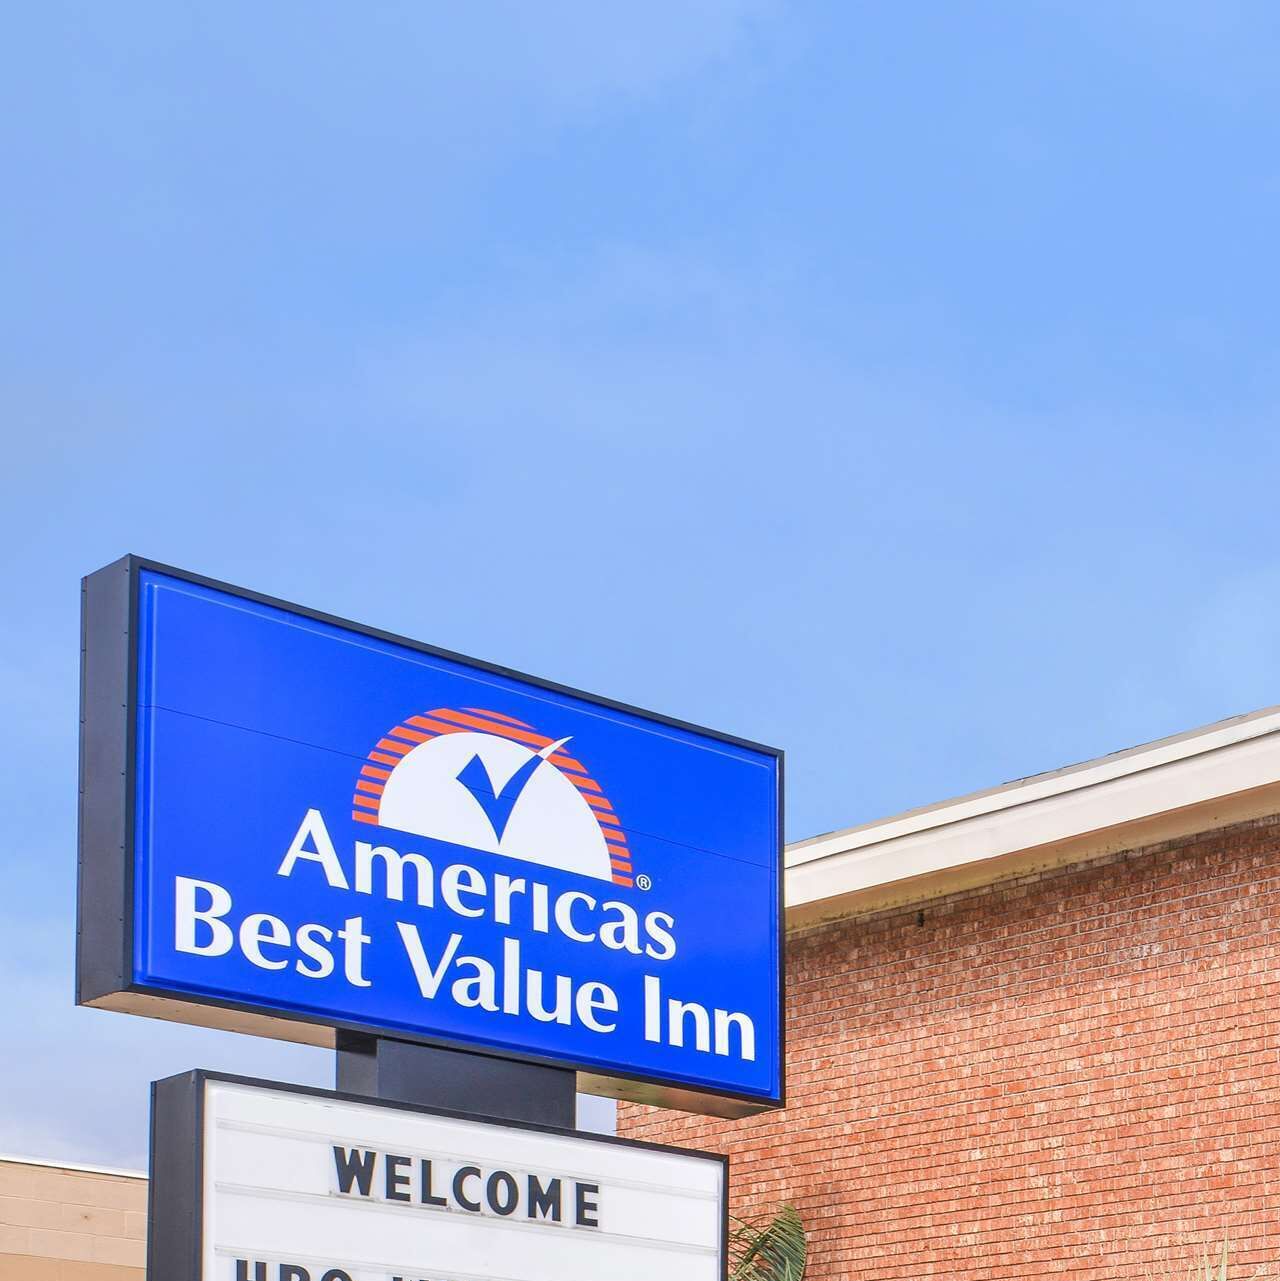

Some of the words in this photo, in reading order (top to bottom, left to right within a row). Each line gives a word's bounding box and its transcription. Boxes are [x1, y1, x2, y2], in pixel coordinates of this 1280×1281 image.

[277, 808, 677, 961] Americas
[174, 875, 372, 987] Best
[396, 921, 619, 1034] Value
[643, 974, 756, 1062] Inn
[333, 1145, 600, 1228] WELCOME
